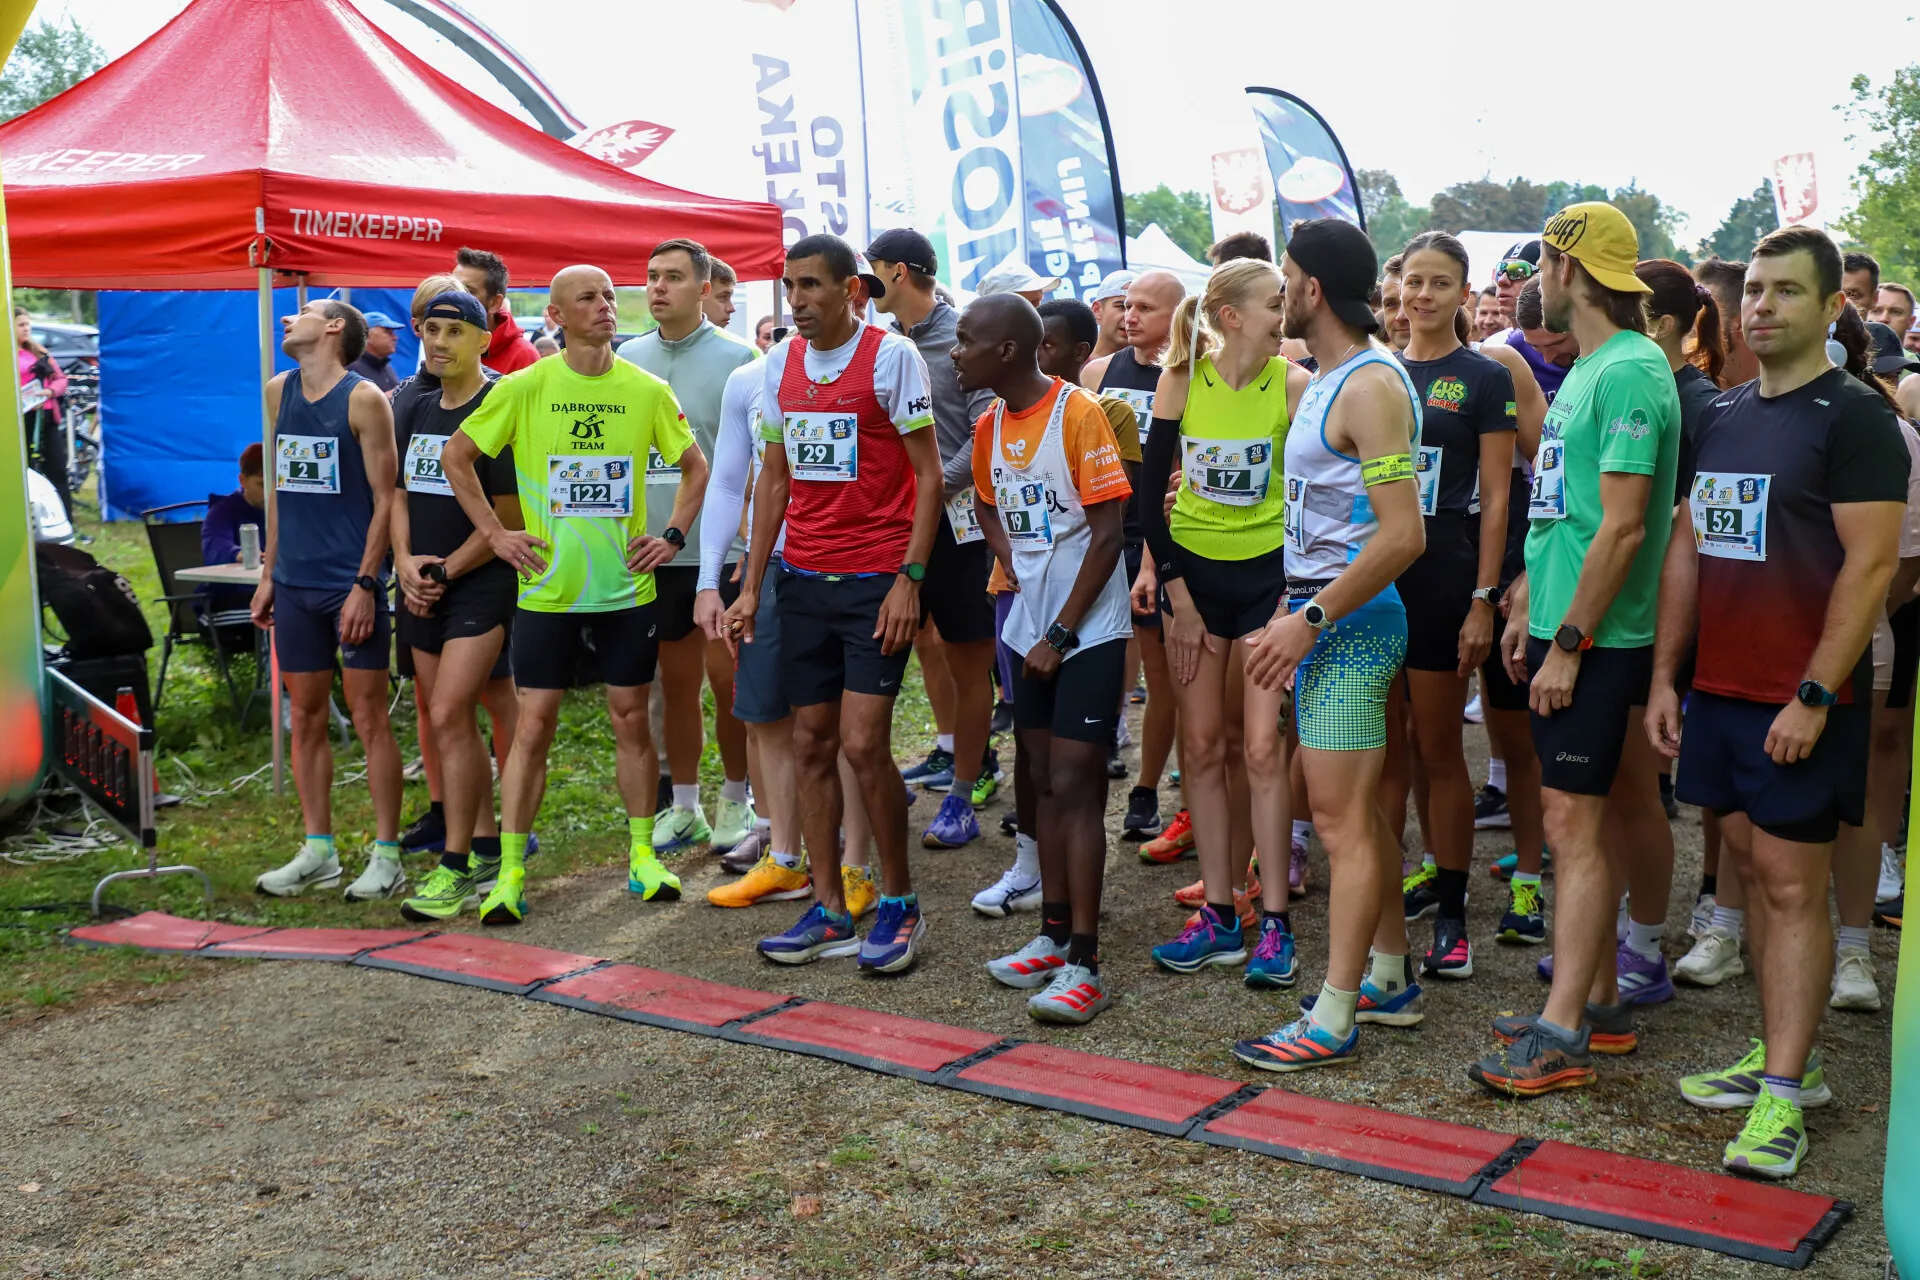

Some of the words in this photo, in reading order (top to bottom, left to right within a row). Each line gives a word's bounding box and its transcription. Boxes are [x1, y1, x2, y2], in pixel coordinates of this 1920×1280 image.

[288, 207, 444, 242] TIMEKEEPER
[550, 402, 626, 414] DĄBROWSKI
[834, 420, 845, 429] 20
[790, 428, 806, 438] OKA
[571, 441, 605, 450] TEAM
[1252, 446, 1262, 454] 20
[804, 444, 828, 463] 29
[1084, 444, 1116, 462] AVAN
[1095, 453, 1120, 468] FIBR
[1196, 454, 1218, 464] OKA
[298, 462, 308, 478] 2
[419, 459, 438, 476] 32
[610, 462, 620, 471] 20
[560, 470, 580, 478] OKA
[1217, 471, 1241, 488] 17
[1026, 486, 1034, 496] 20
[1743, 480, 1754, 491] 20
[573, 485, 608, 502] 122
[1697, 489, 1714, 500] OKA
[1010, 512, 1022, 531] 19
[1712, 510, 1735, 533] 52
[1565, 754, 1590, 764] asics
